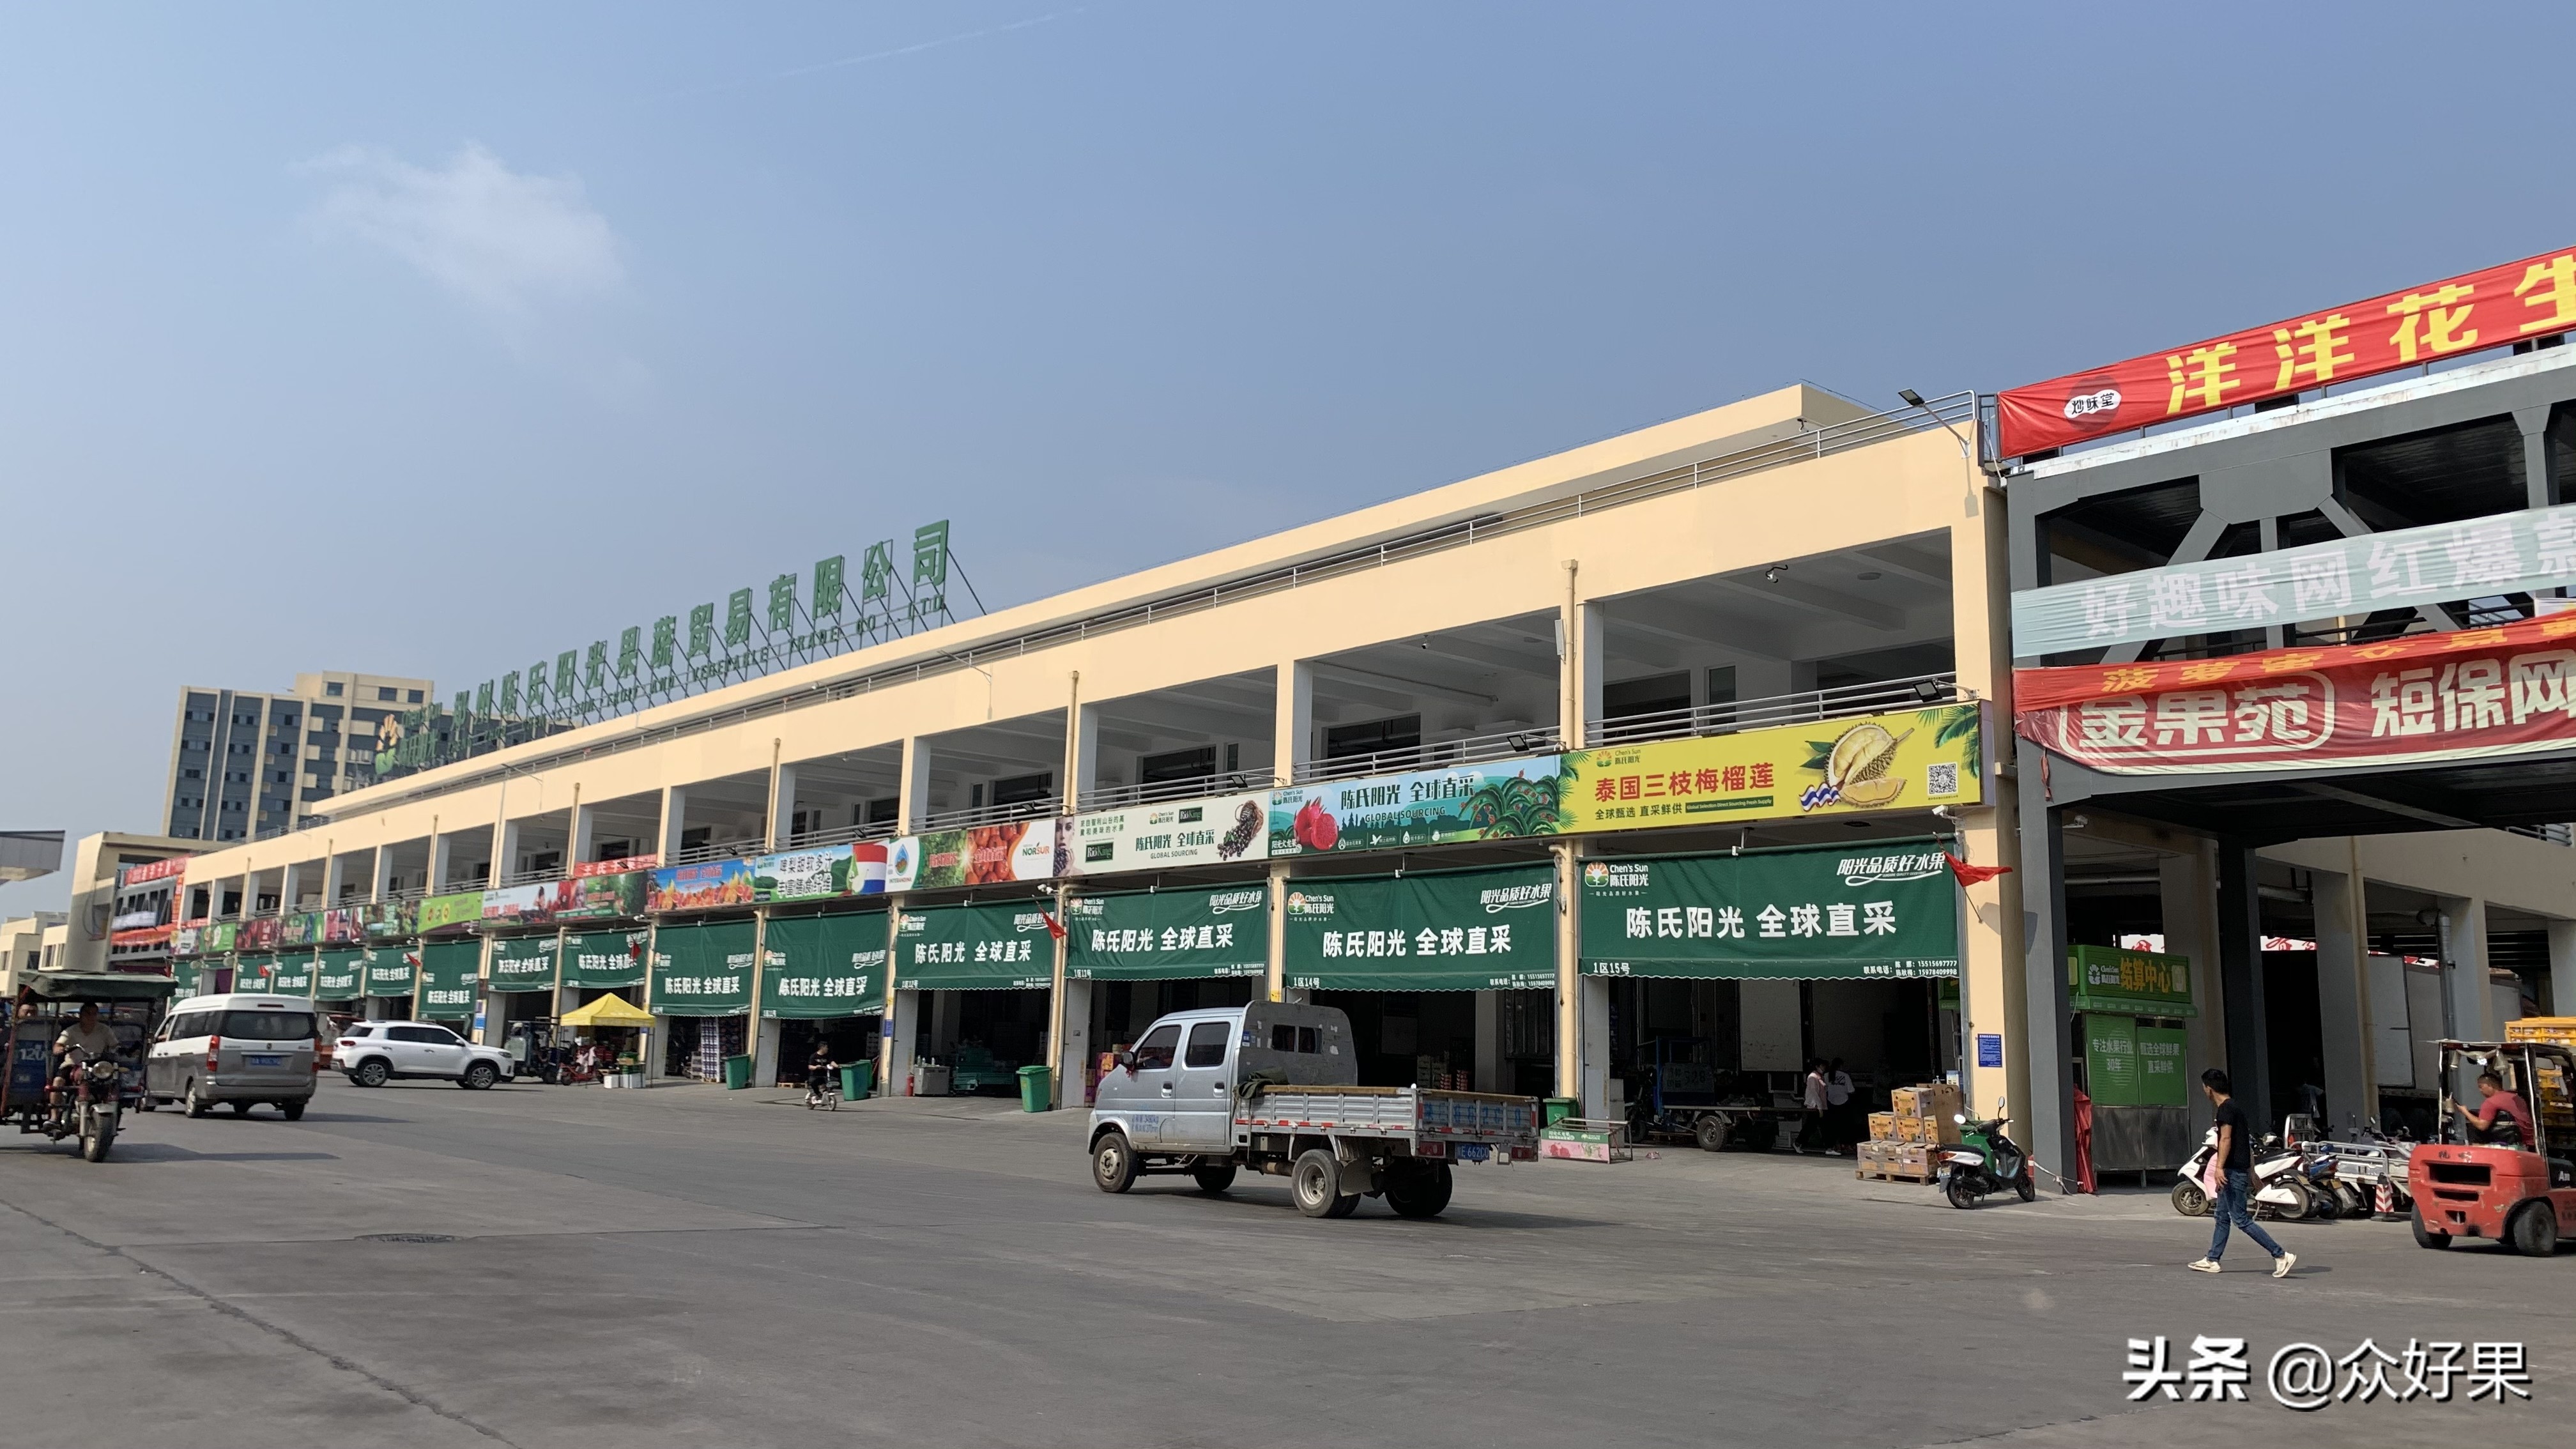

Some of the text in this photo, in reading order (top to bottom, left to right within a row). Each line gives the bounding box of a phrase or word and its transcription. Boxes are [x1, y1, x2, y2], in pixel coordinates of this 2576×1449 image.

[2166, 255, 2576, 415] 洋洋花生
[1595, 762, 1774, 802] 泰国三枝梅榴莲
[1340, 775, 1475, 811] 陈氏阳光 全球直采
[1365, 805, 1446, 823] GLOBAL SOURCING
[1595, 802, 1682, 820] 全球甄选 直采鲜供
[1135, 829, 1215, 852] 陈氏阳光 全球直采
[1150, 848, 1198, 859] GLOBAL SOURCING
[1836, 852, 1946, 875] 阳光品质好水果
[1610, 864, 1648, 873] Chen's Sun
[1609, 874, 1649, 887] 陈氏阳光
[1209, 891, 1262, 907] 阳光品质好水果
[1480, 883, 1552, 905] 阳光品质好水果
[1304, 903, 1334, 914] 陈氏阳光
[1626, 901, 1897, 939] 陈氏阳光 全球直采
[1092, 923, 1234, 953] 陈氏阳光 全球直采
[1322, 924, 1512, 958] 陈氏阳光 全球直采
[915, 940, 1032, 964] 陈氏阳光 全球直采
[1593, 962, 1630, 975] 1区15号
[2120, 956, 2171, 993] 结算中心
[665, 976, 740, 995] 陈氏阳光 全球直采
[779, 976, 868, 997] 陈氏阳光 全球直采
[1293, 977, 1320, 988] 1区14号
[2092, 1038, 2134, 1055] 专注水果行业
